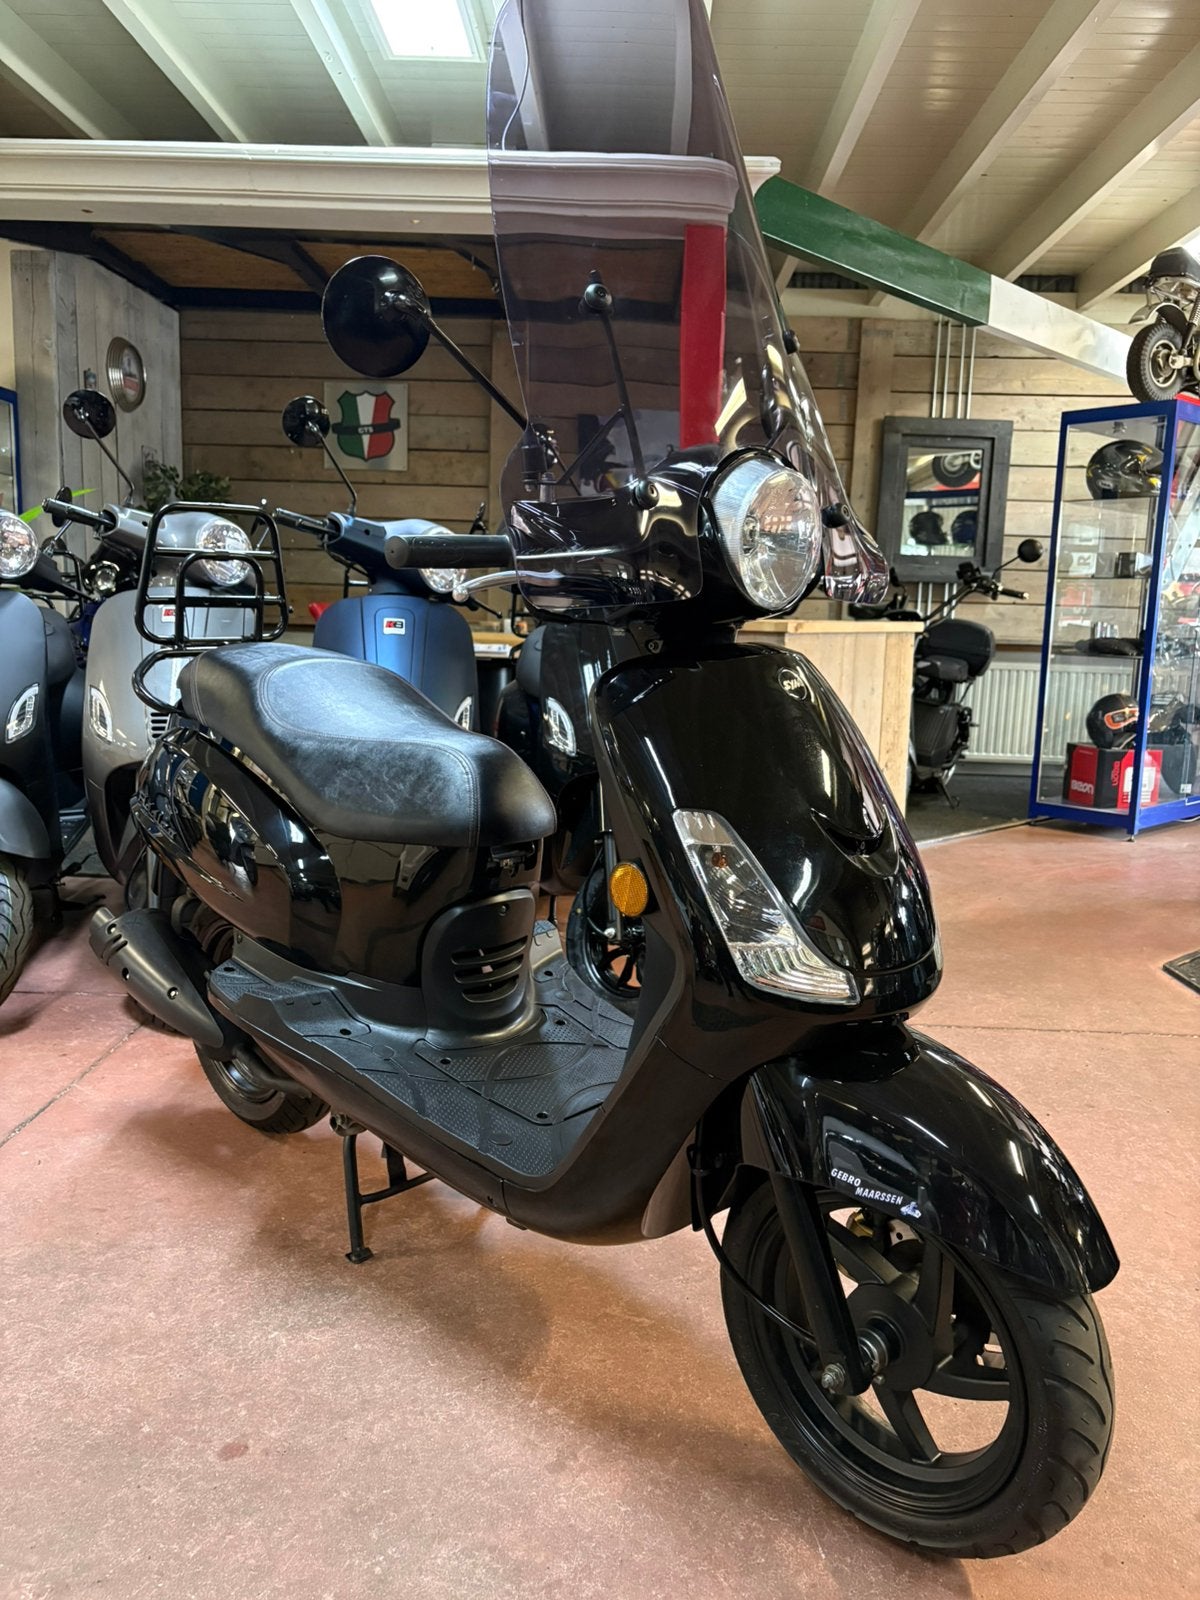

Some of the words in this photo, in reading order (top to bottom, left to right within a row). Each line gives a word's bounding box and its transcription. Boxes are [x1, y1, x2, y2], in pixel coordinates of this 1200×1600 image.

[783, 678, 804, 690] SYM
[830, 1168, 861, 1186] GEBRO
[855, 1187, 904, 1205] MAARSSEN
